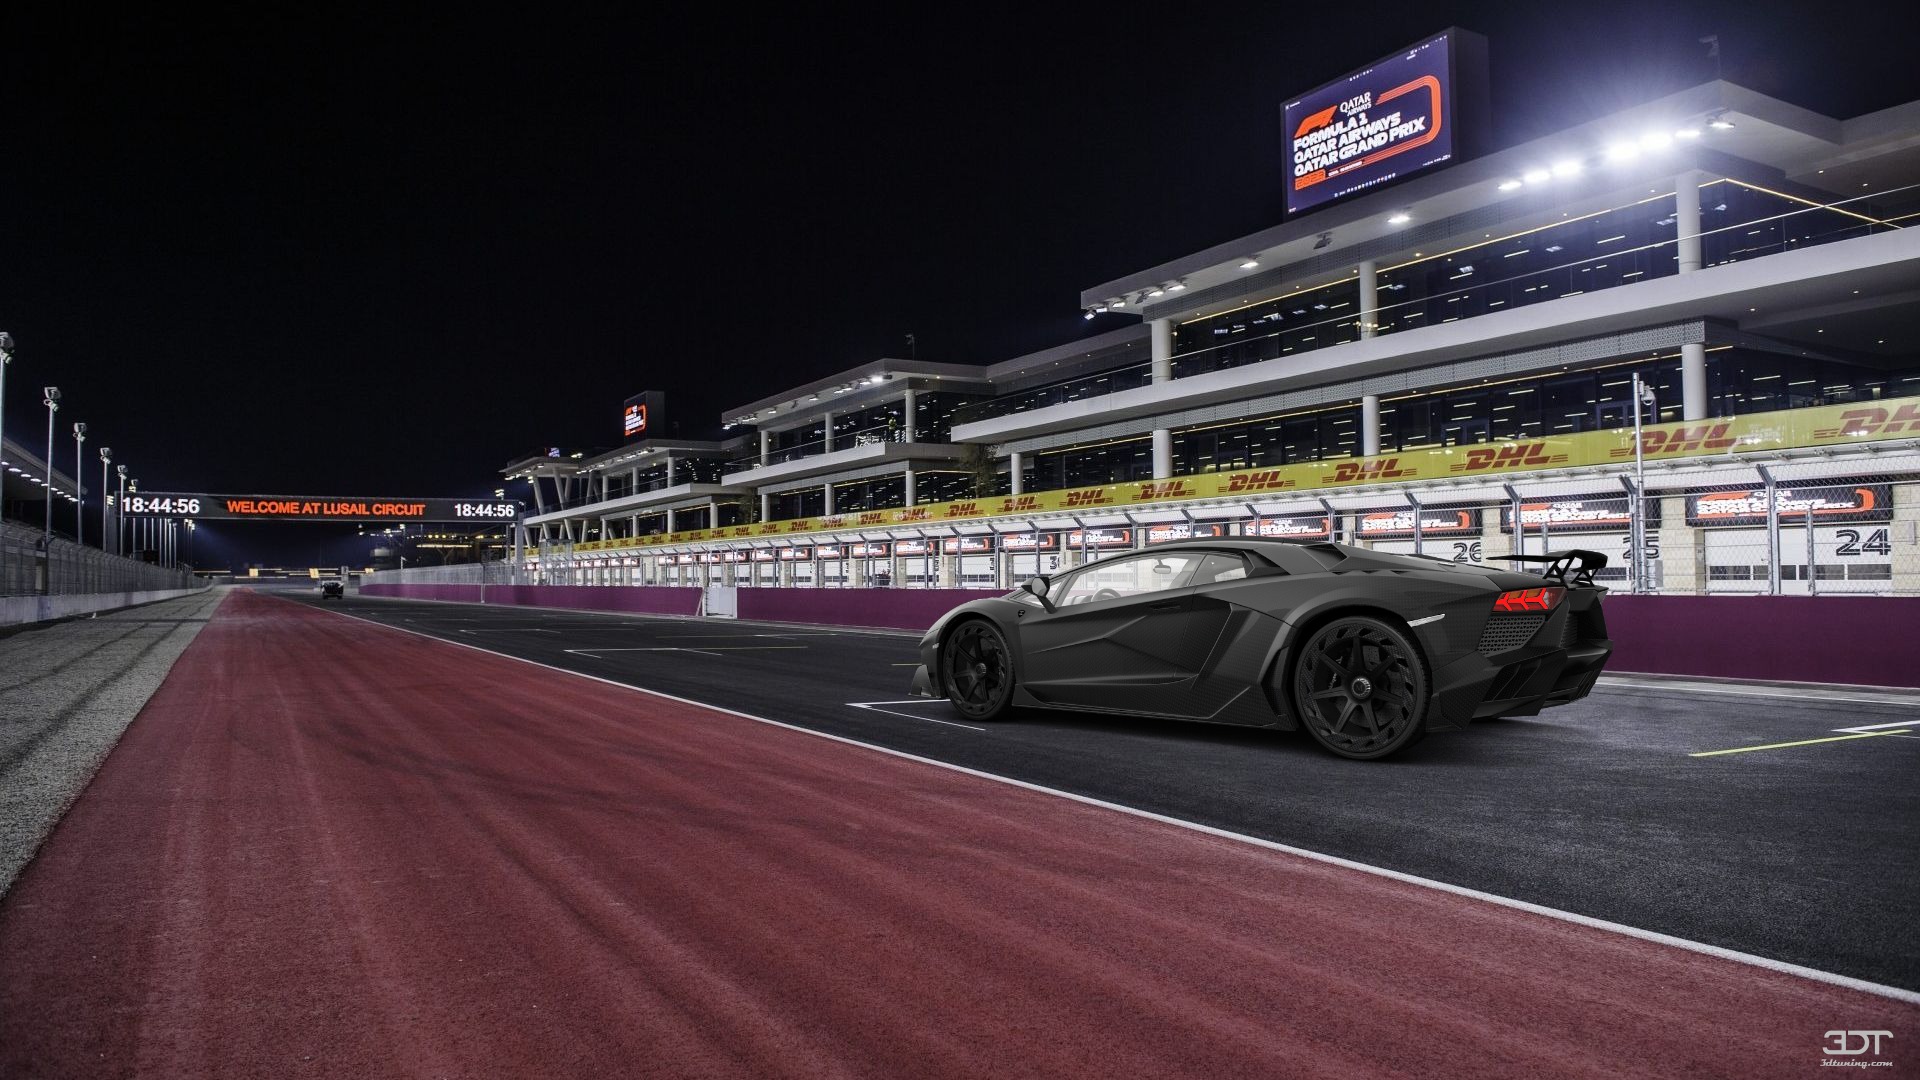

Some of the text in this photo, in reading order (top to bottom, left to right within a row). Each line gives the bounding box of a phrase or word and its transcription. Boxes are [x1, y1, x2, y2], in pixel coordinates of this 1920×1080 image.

[1339, 91, 1371, 113] QATAR
[1347, 102, 1372, 117] AIRWAYS
[1293, 116, 1358, 152] FORMULA
[1294, 112, 1401, 164] QATAR AIRWAYS
[1294, 150, 1339, 177] QATAR
[1338, 132, 1389, 160] GRAND
[1388, 116, 1426, 143] PRIX
[1629, 423, 1739, 456] DHL
[1465, 443, 1551, 470] DHL
[1334, 458, 1404, 482] DHL
[1140, 481, 1186, 500] DHL
[1228, 470, 1284, 492] DHL
[122, 497, 200, 514] 18:44:56
[227, 500, 426, 516] WELCOME AT LUSAIL CIRCUIT
[1003, 496, 1037, 512] DHL
[1066, 489, 1106, 507] DHL
[454, 503, 515, 518] 18:44:56
[860, 513, 883, 525] DHL
[949, 503, 978, 517] DHL
[1453, 541, 1482, 562] 26
[1835, 528, 1892, 556] 24
